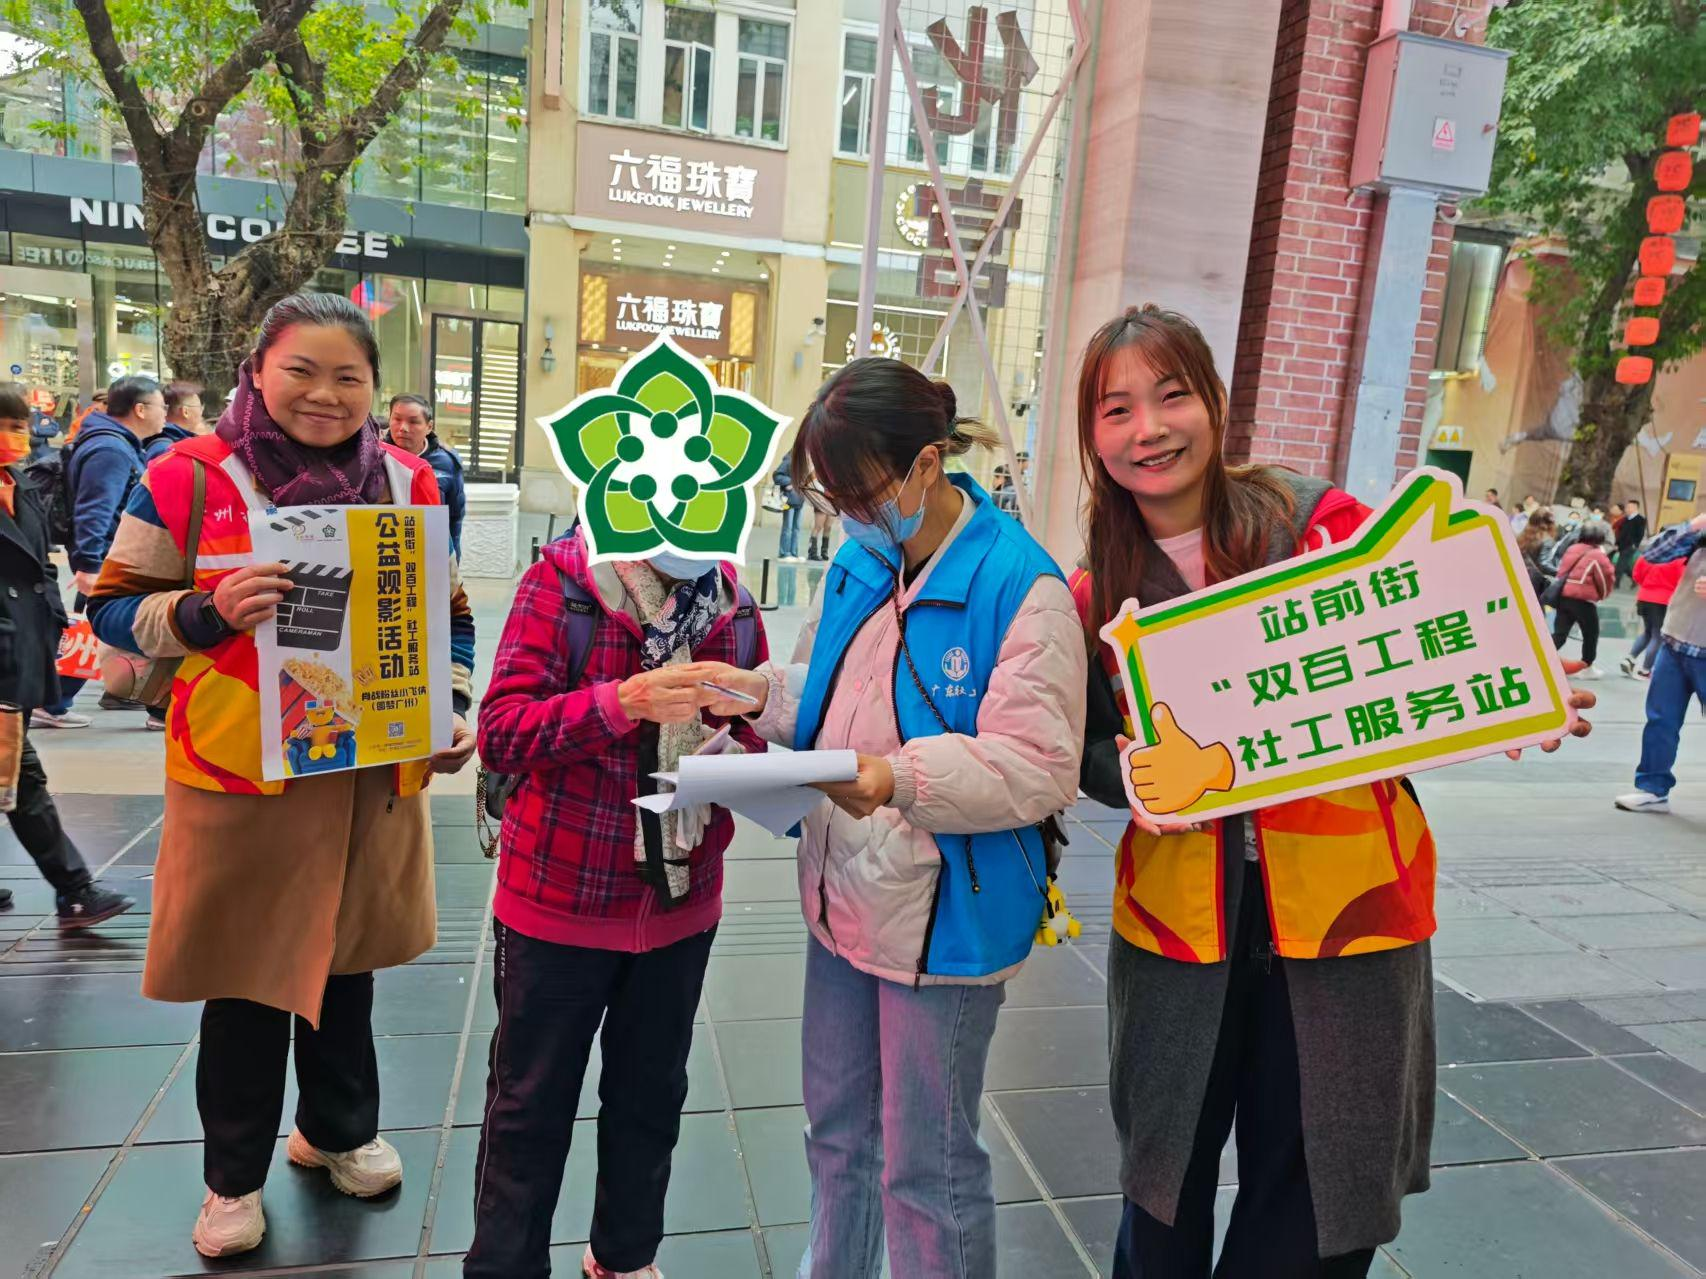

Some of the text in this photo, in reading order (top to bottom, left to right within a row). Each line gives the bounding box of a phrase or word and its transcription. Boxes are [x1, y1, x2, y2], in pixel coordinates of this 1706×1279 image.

[608, 148, 759, 204] 六福珠寶
[69, 196, 147, 231] NIN
[608, 187, 755, 219] LUKFOOK JEWELLERY
[615, 292, 725, 330] 六福珠寶
[296, 605, 313, 613] ROLL
[375, 512, 404, 680] 公益观影活动
[1256, 559, 1421, 644] 站前街
[278, 627, 323, 637] CAMERAMAN
[1236, 666, 1532, 773] 社工服务站
